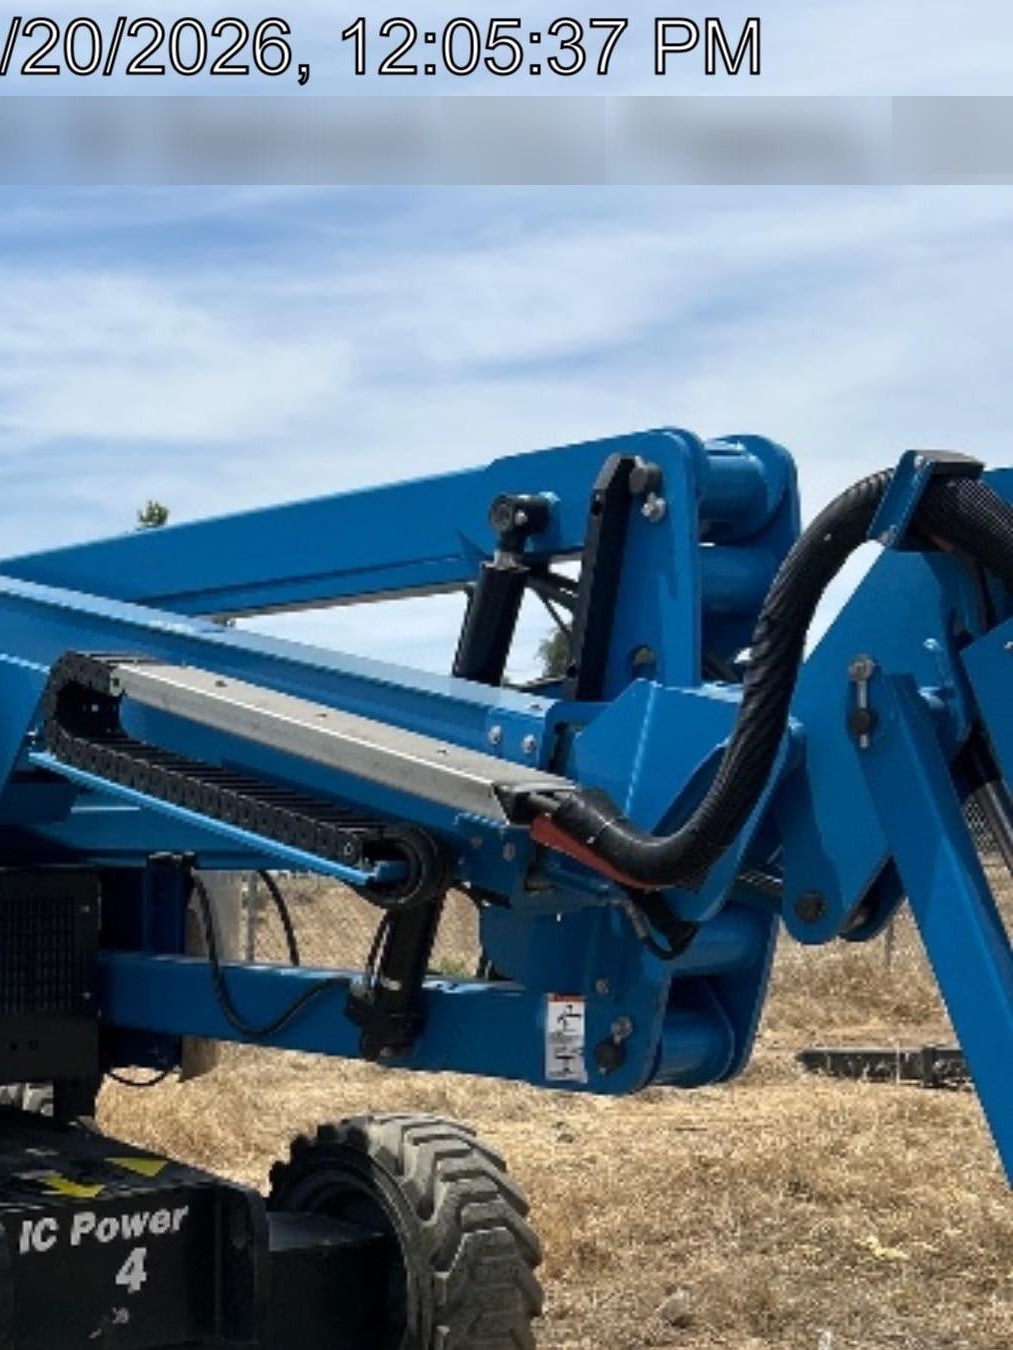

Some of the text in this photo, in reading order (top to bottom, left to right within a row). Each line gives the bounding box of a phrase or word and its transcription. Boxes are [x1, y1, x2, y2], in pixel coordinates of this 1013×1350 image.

[20, 1205, 189, 1253] IC Power
[115, 1247, 148, 1292] 4
